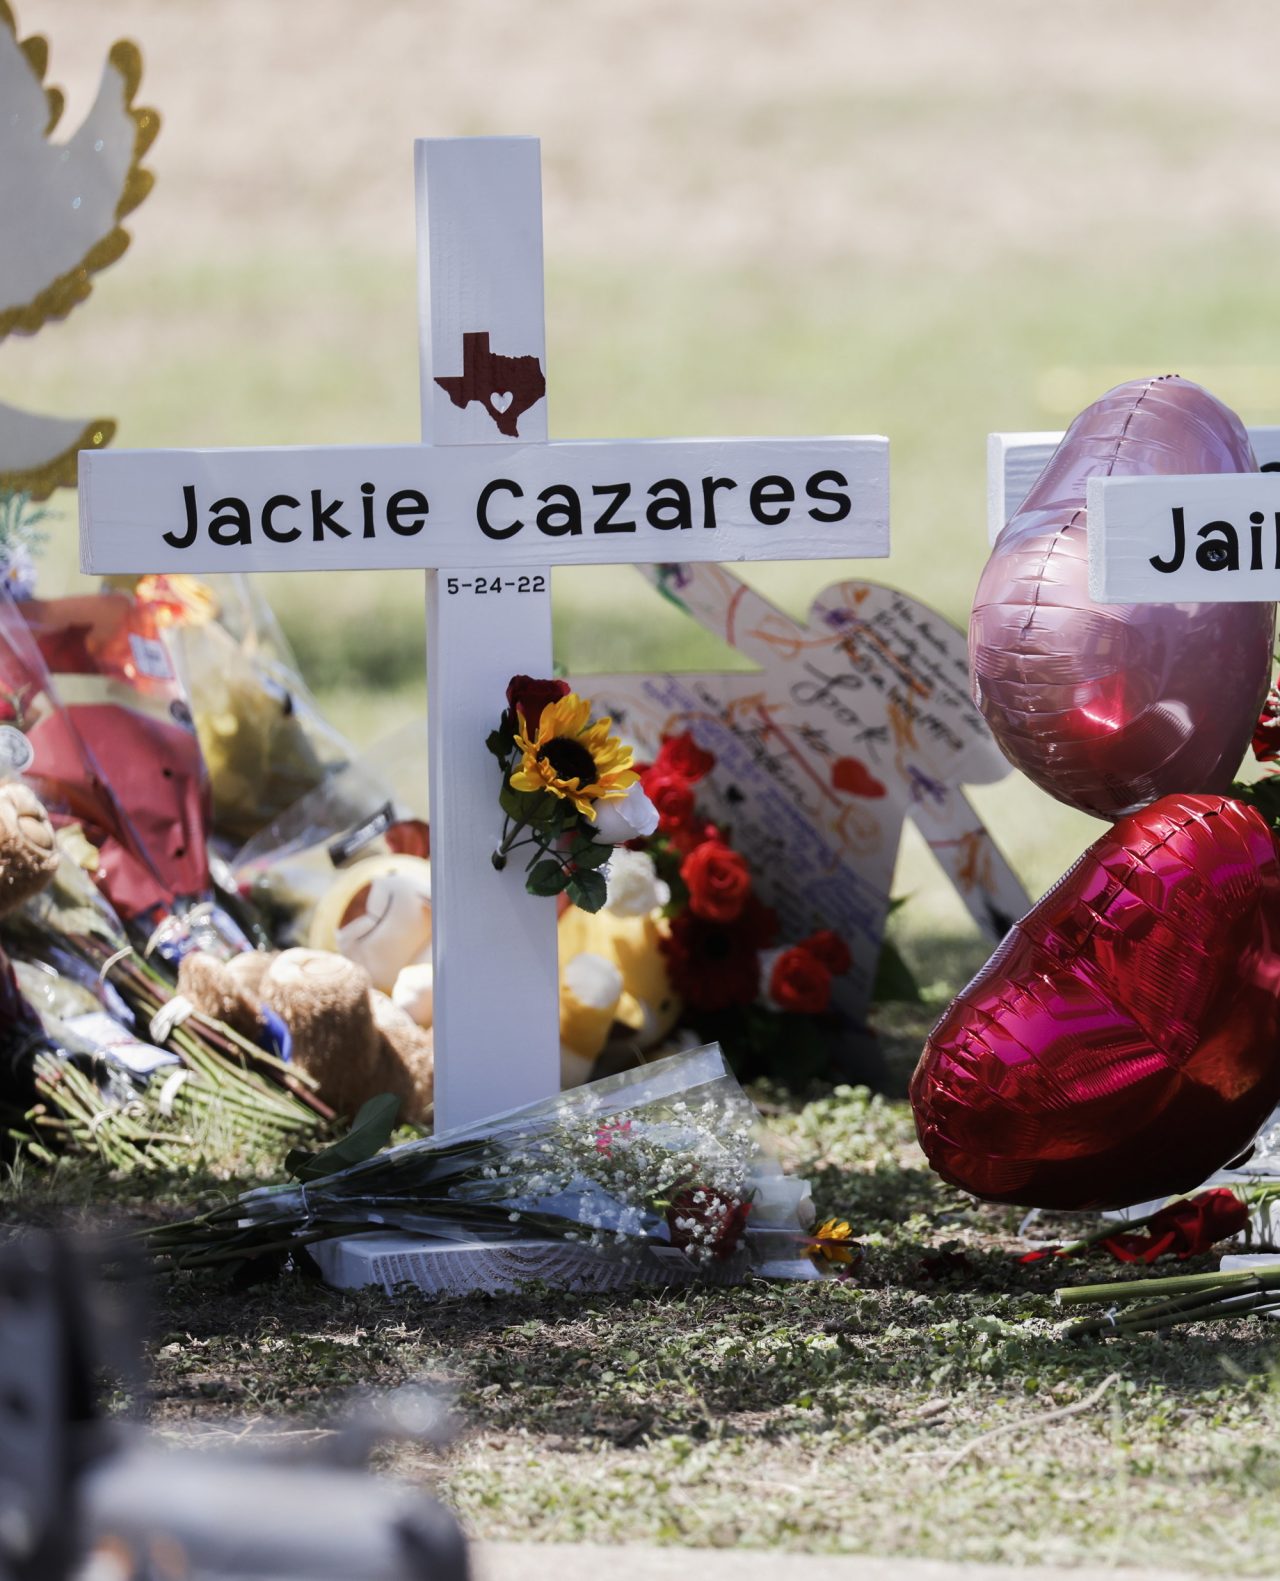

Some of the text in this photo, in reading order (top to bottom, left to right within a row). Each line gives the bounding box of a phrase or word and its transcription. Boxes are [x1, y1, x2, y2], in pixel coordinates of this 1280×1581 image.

[161, 469, 852, 550] Jackie Cazares
[447, 575, 546, 595] 5-24-22
